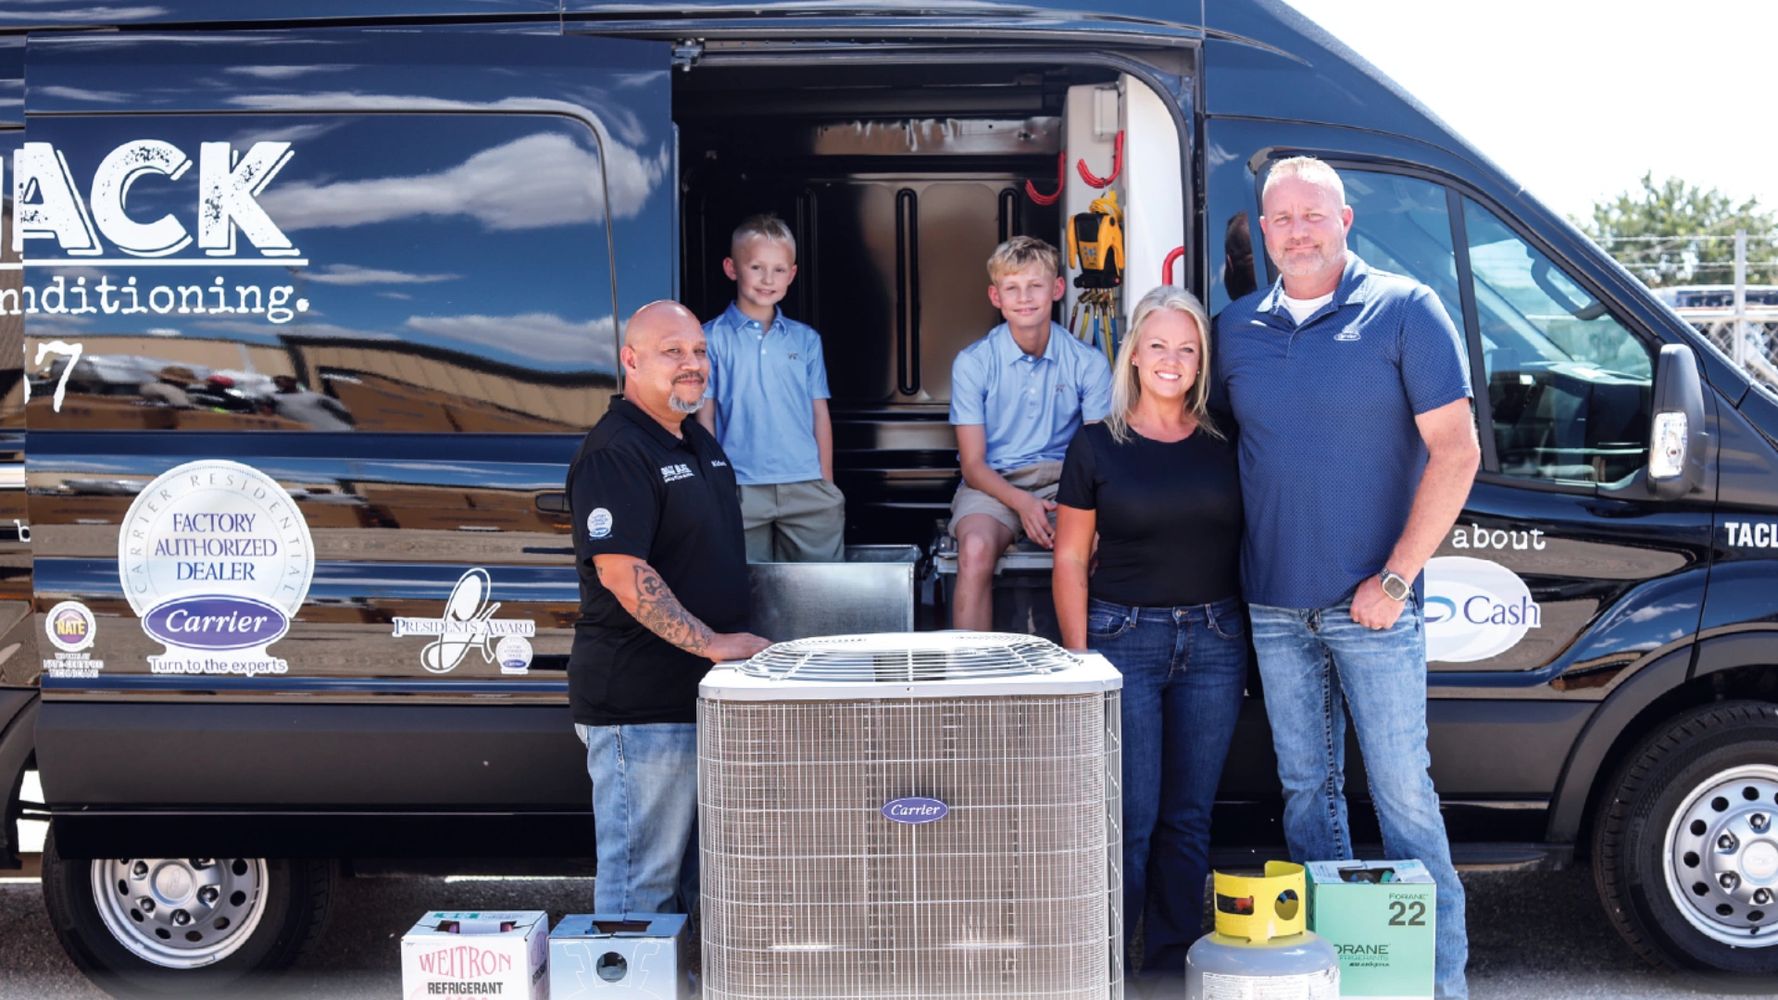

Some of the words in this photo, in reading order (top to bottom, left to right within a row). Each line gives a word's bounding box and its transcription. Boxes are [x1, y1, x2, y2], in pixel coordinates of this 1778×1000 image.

[0, 139, 300, 258] ACK
[23, 340, 83, 413] 7
[173, 513, 256, 532] FACTORY
[131, 490, 172, 594] CARRIER
[190, 473, 302, 592] RESIDENTIAL
[1452, 523, 1546, 550] about
[154, 538, 278, 557] AUTHORIZED
[176, 562, 256, 581] DEALER
[1463, 595, 1538, 625] Cash
[55, 619, 86, 635] NATE
[166, 609, 268, 633] Carrier
[481, 620, 534, 636] AWARD
[150, 658, 183, 671] Turn
[187, 660, 201, 671] to
[205, 659, 228, 671] the
[232, 660, 286, 674] experts
[891, 804, 940, 816] Carrier
[1388, 901, 1426, 926] 22
[1333, 944, 1389, 955] ORANE
[419, 946, 511, 979] WEITRON
[428, 982, 503, 995] REFRIGERANT
